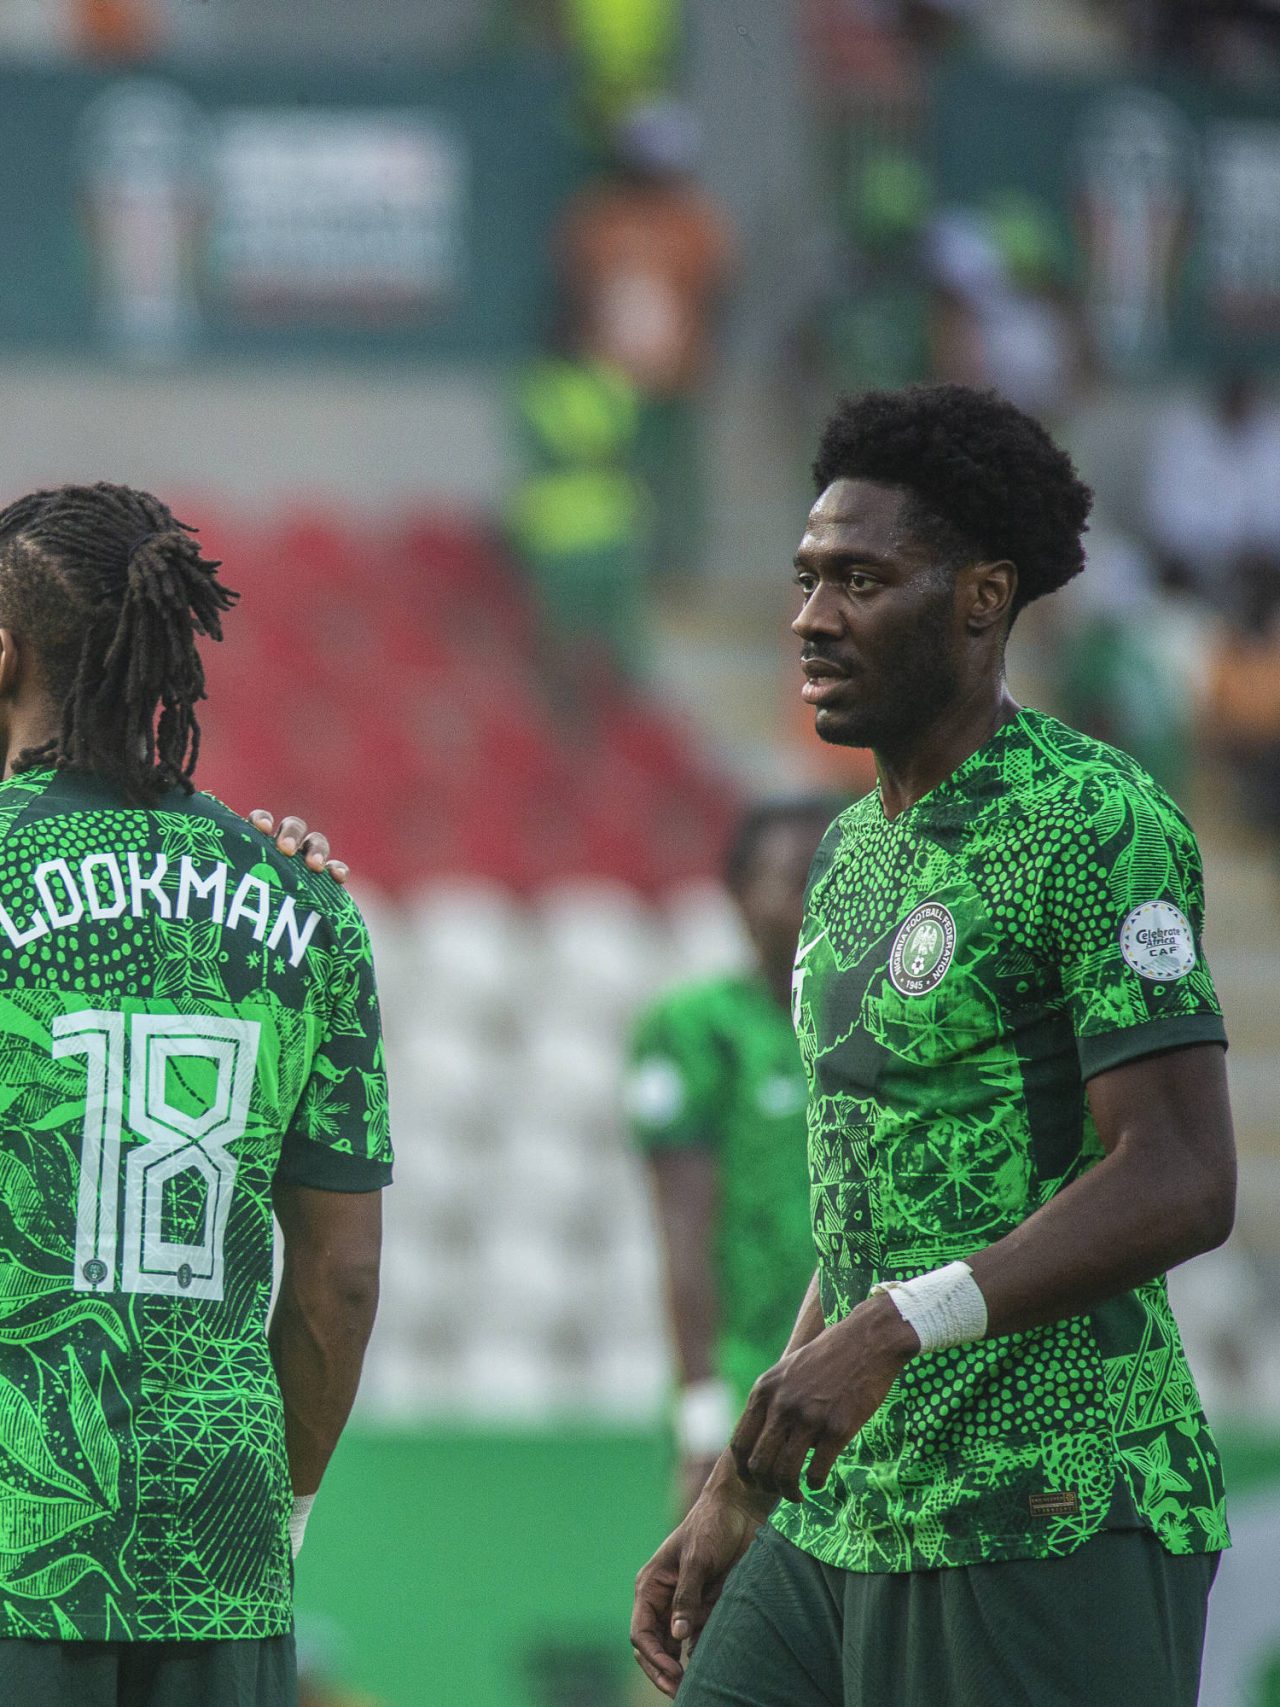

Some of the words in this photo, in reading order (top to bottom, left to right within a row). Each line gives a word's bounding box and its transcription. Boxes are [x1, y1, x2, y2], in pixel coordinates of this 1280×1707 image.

[1136, 928, 1181, 944] Celebrate
[1146, 937, 1176, 948] Africa
[893, 933, 908, 976] NIGERIA
[906, 908, 943, 932] FOOTBALL
[932, 916, 953, 981] FEDERATION
[1149, 946, 1177, 957] CAF
[906, 979, 924, 990] 1945
[52, 1009, 262, 1300] 18
